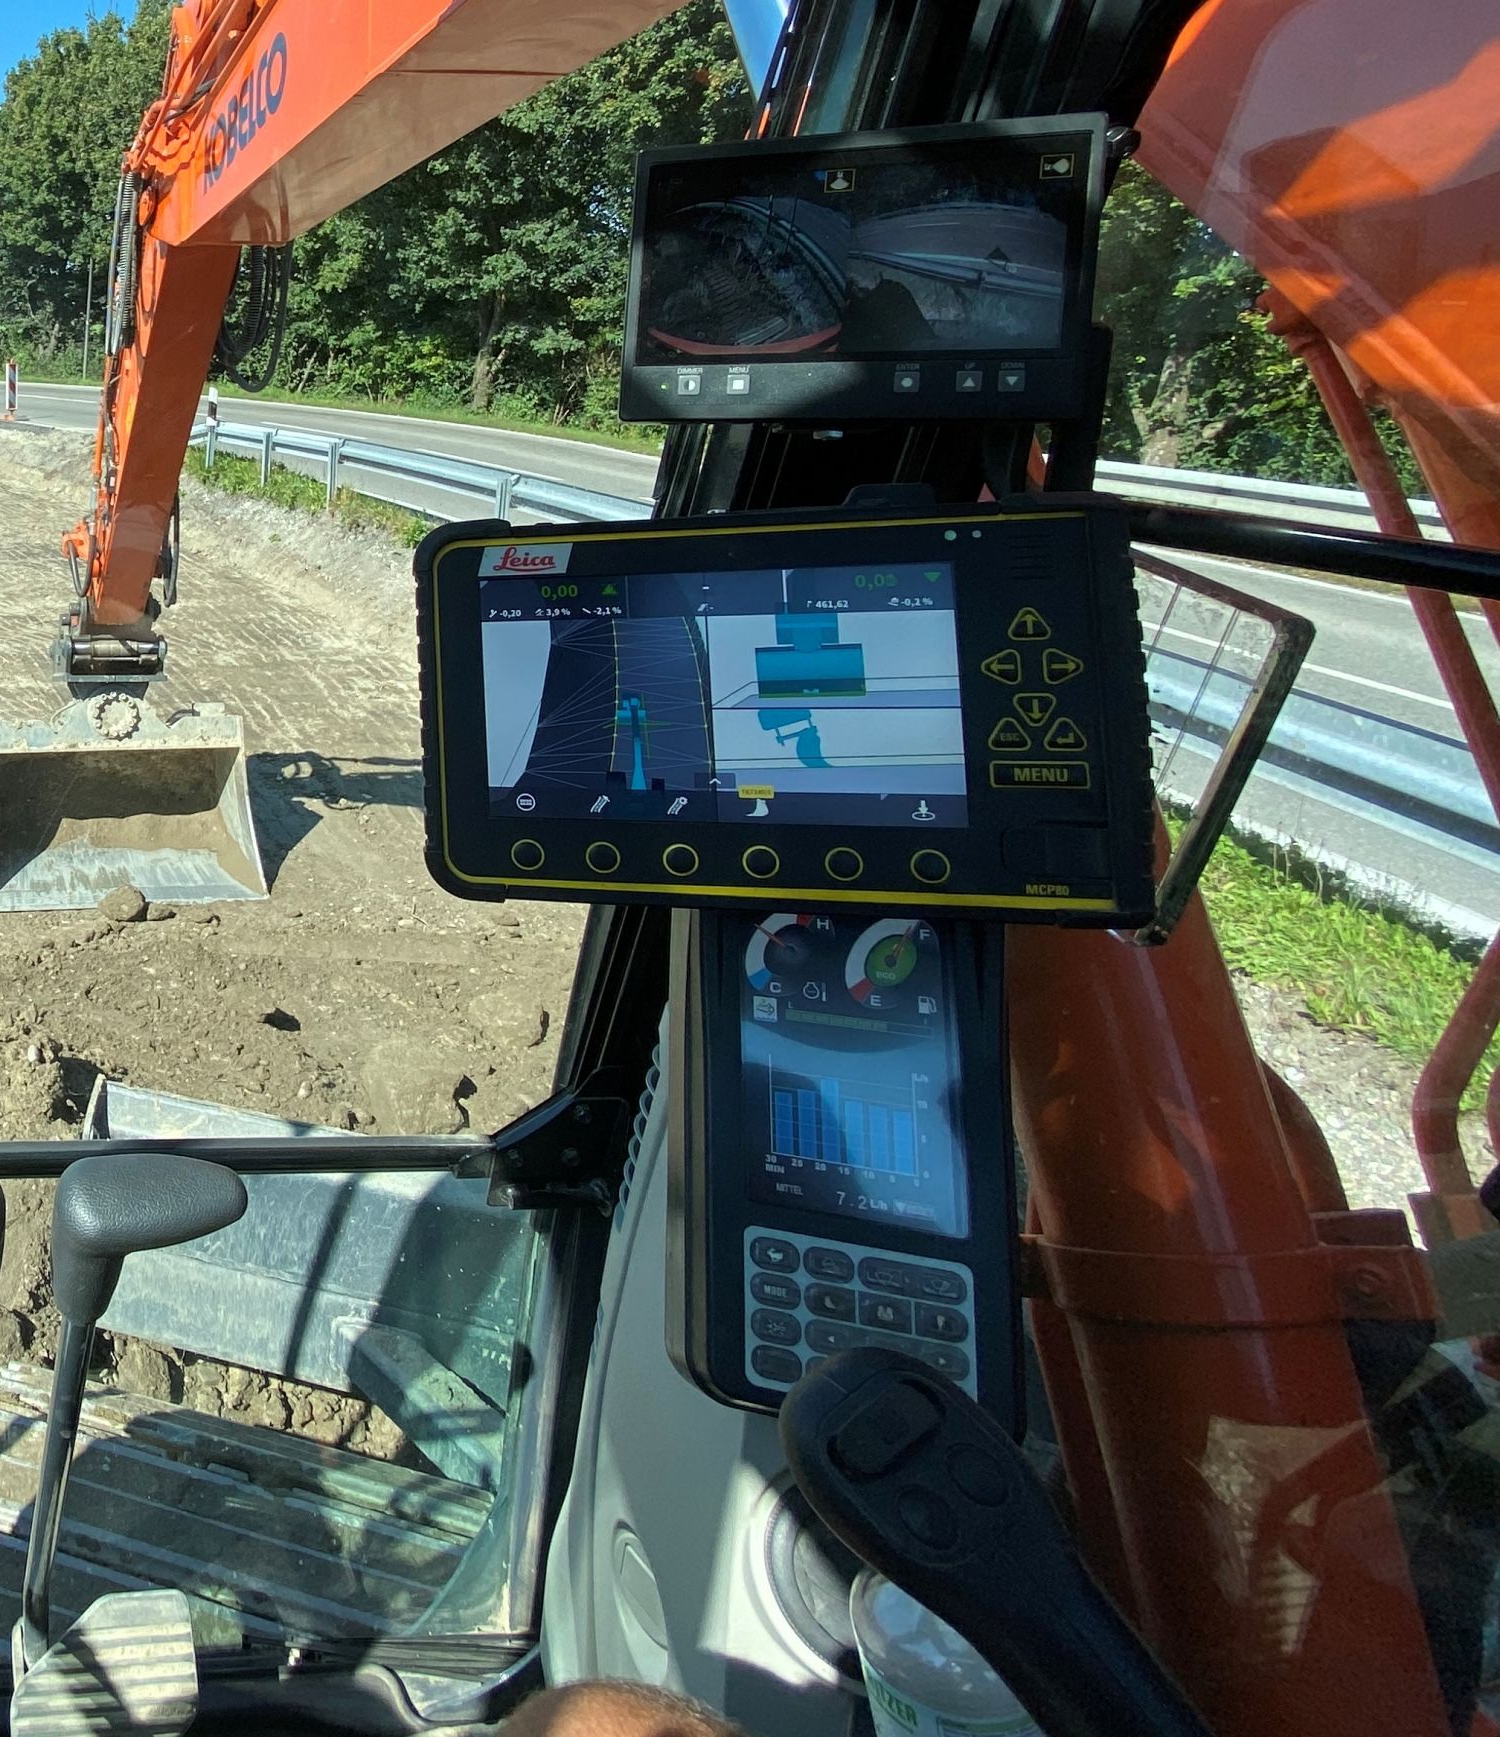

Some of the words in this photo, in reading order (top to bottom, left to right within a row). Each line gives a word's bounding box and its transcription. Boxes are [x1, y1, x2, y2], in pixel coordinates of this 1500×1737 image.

[203, 32, 287, 194] KOBELCO
[677, 367, 703, 375] DIMMER
[728, 365, 750, 374] MENU
[493, 546, 557, 572] Leica
[541, 585, 578, 600] 0,00
[1013, 767, 1068, 782] MENU
[817, 919, 829, 930] H
[919, 928, 931, 940] F
[769, 981, 782, 993] C
[870, 994, 882, 1007] E
[763, 1284, 788, 1298] MODE
